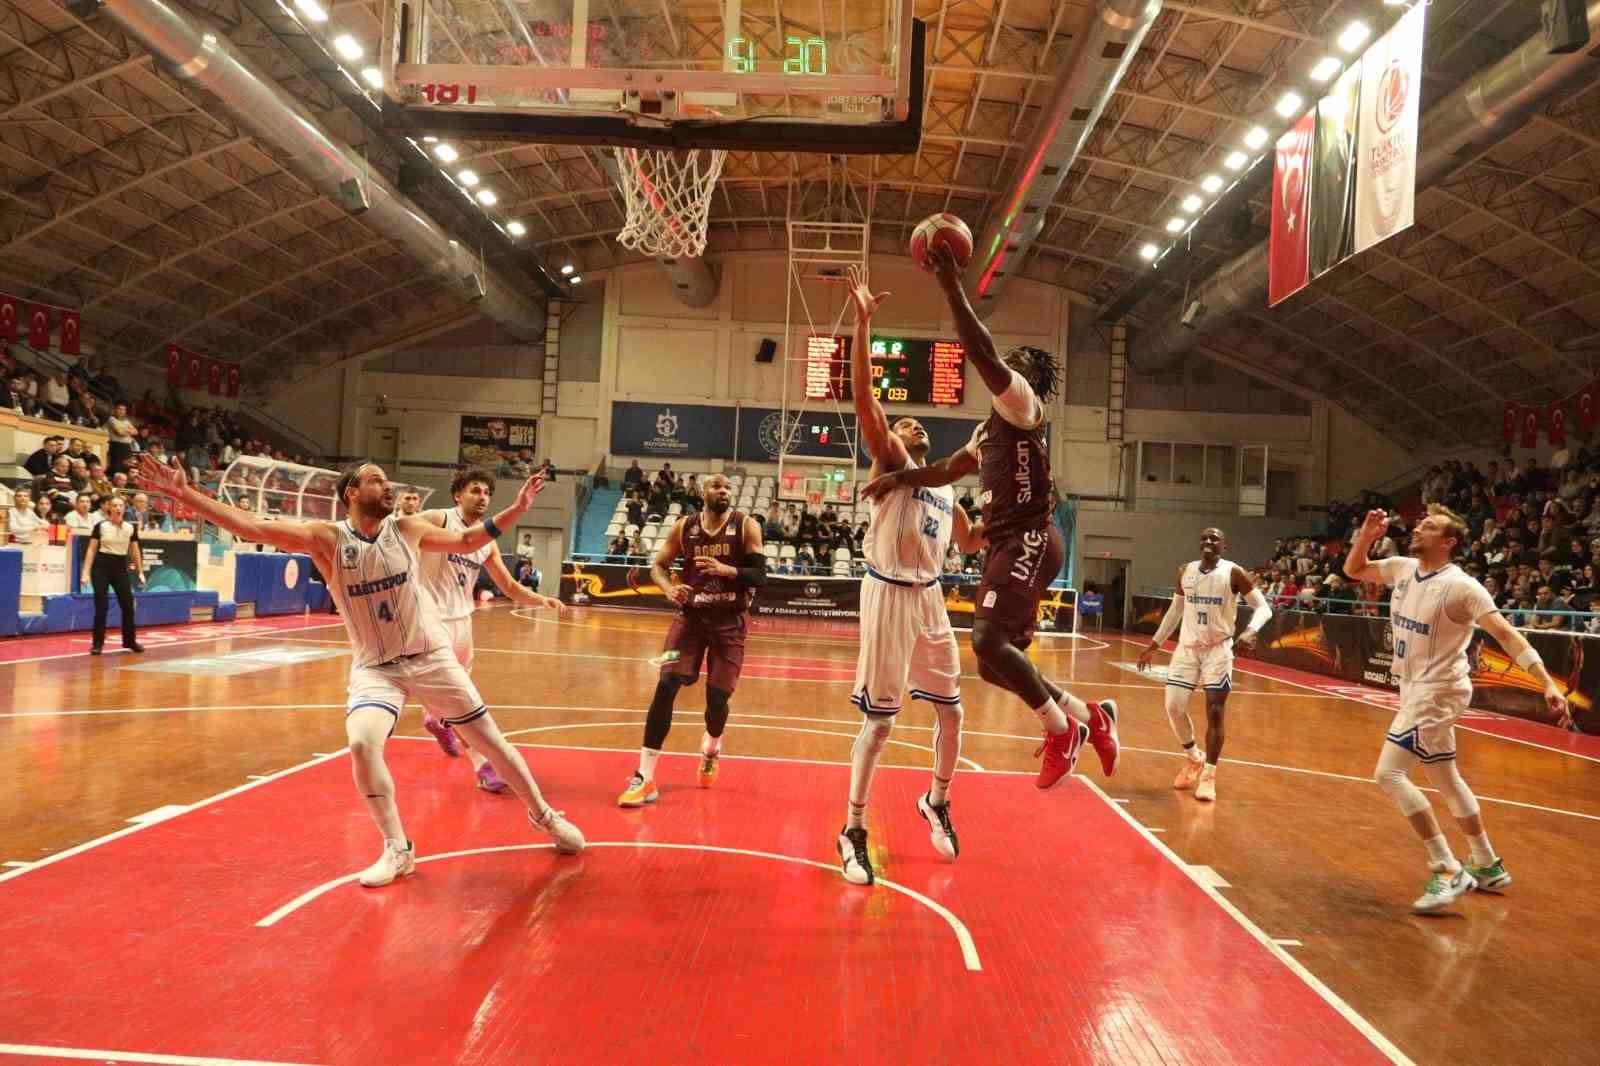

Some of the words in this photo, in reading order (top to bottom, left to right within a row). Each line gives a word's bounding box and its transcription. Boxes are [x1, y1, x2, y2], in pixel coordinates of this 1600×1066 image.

[1017, 440, 1032, 503] Sultan
[923, 515, 940, 538] 22
[378, 599, 394, 623] 4
